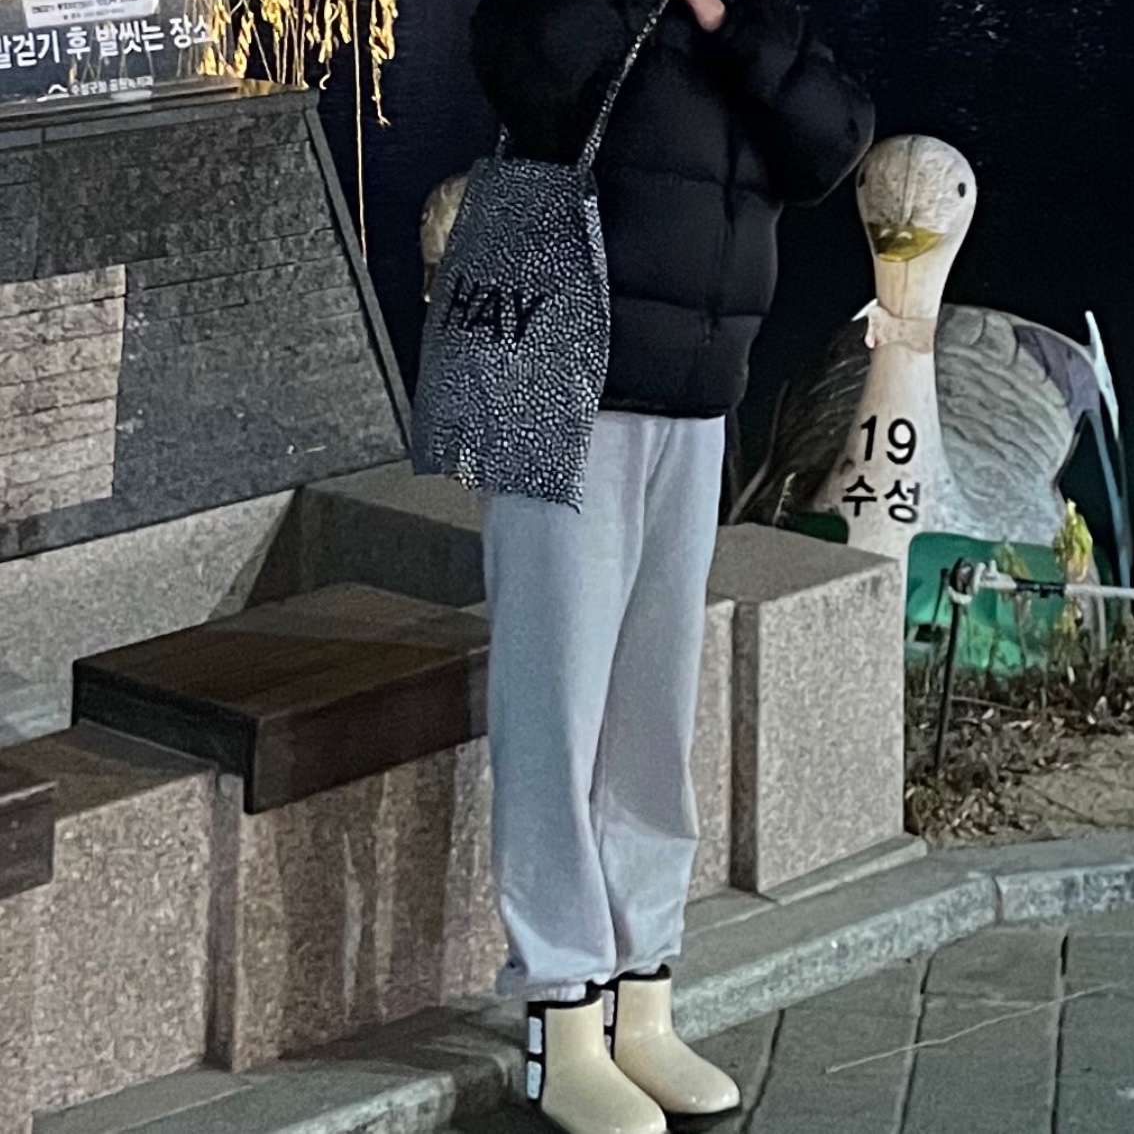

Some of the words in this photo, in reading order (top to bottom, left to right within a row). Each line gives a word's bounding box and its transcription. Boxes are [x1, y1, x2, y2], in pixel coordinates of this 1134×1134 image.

[66, 25, 92, 61] 후
[96, 20, 164, 58] 발씻는
[169, 13, 213, 49] 장소
[860, 415, 917, 465] 19
[842, 475, 921, 524] 수성
